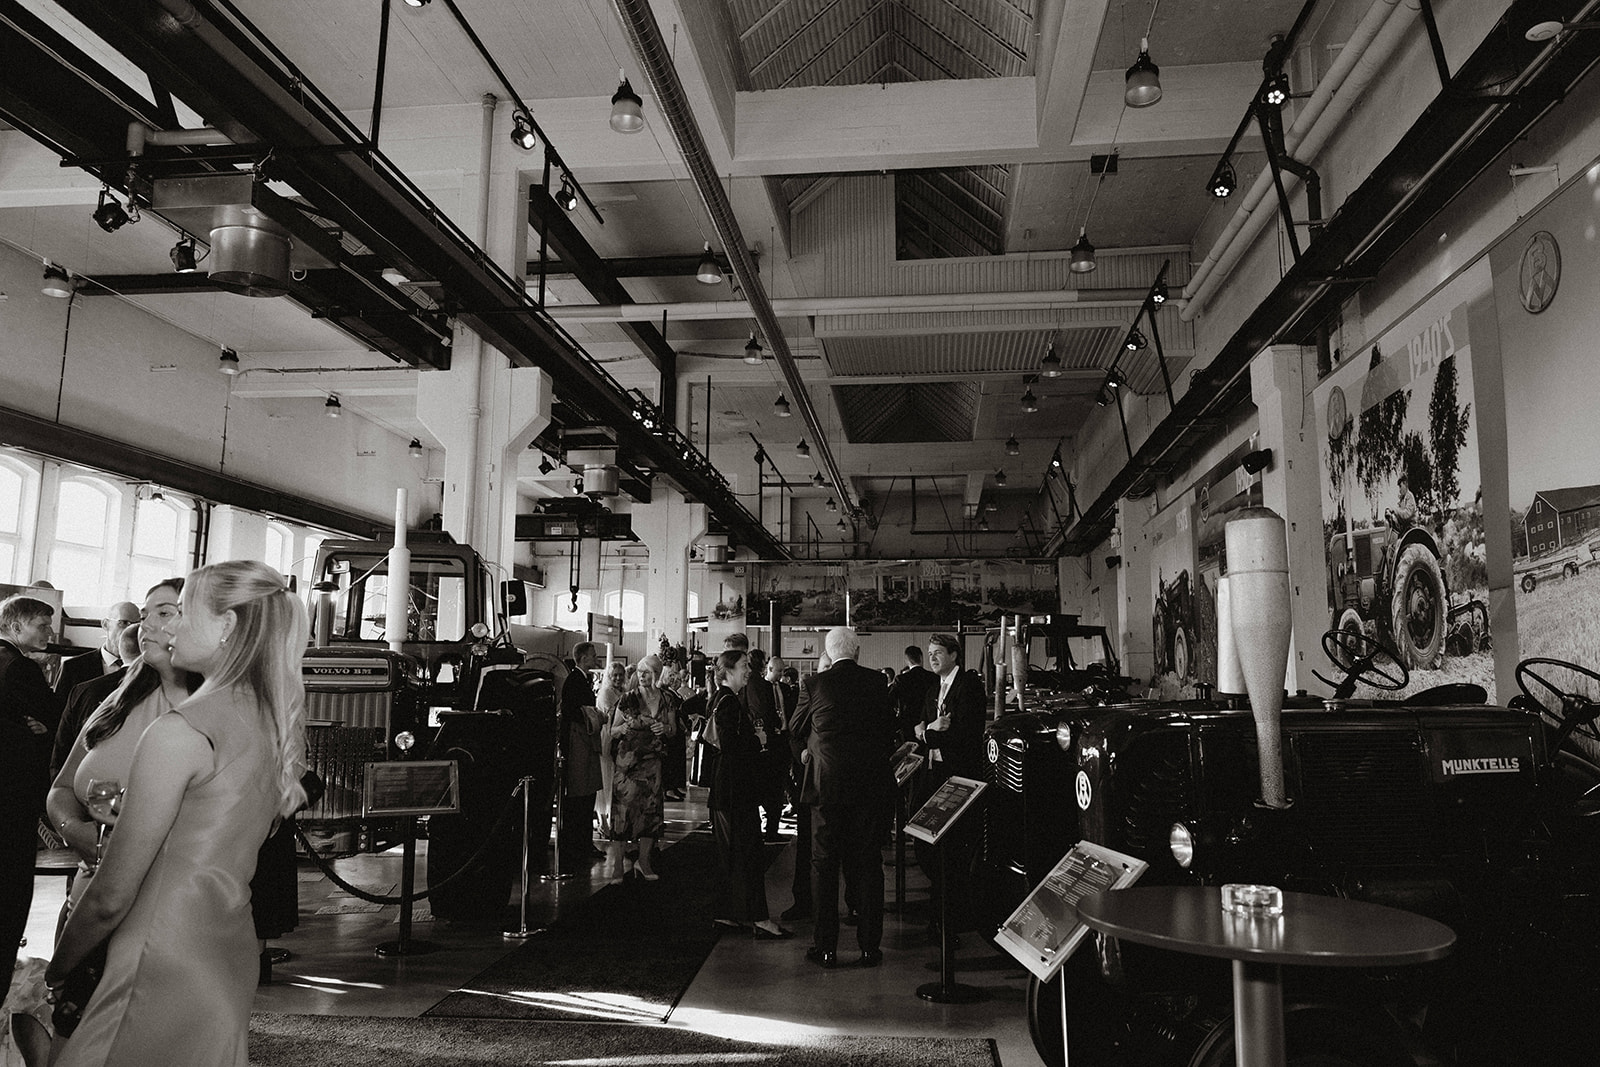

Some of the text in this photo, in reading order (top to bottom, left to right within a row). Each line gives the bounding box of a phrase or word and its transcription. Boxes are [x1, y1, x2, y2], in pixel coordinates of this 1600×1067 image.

[1406, 311, 1454, 383] 1940'S
[826, 566, 843, 577] 1910
[312, 667, 350, 675] VOLVO
[1441, 757, 1520, 775] MUNKTELLS
